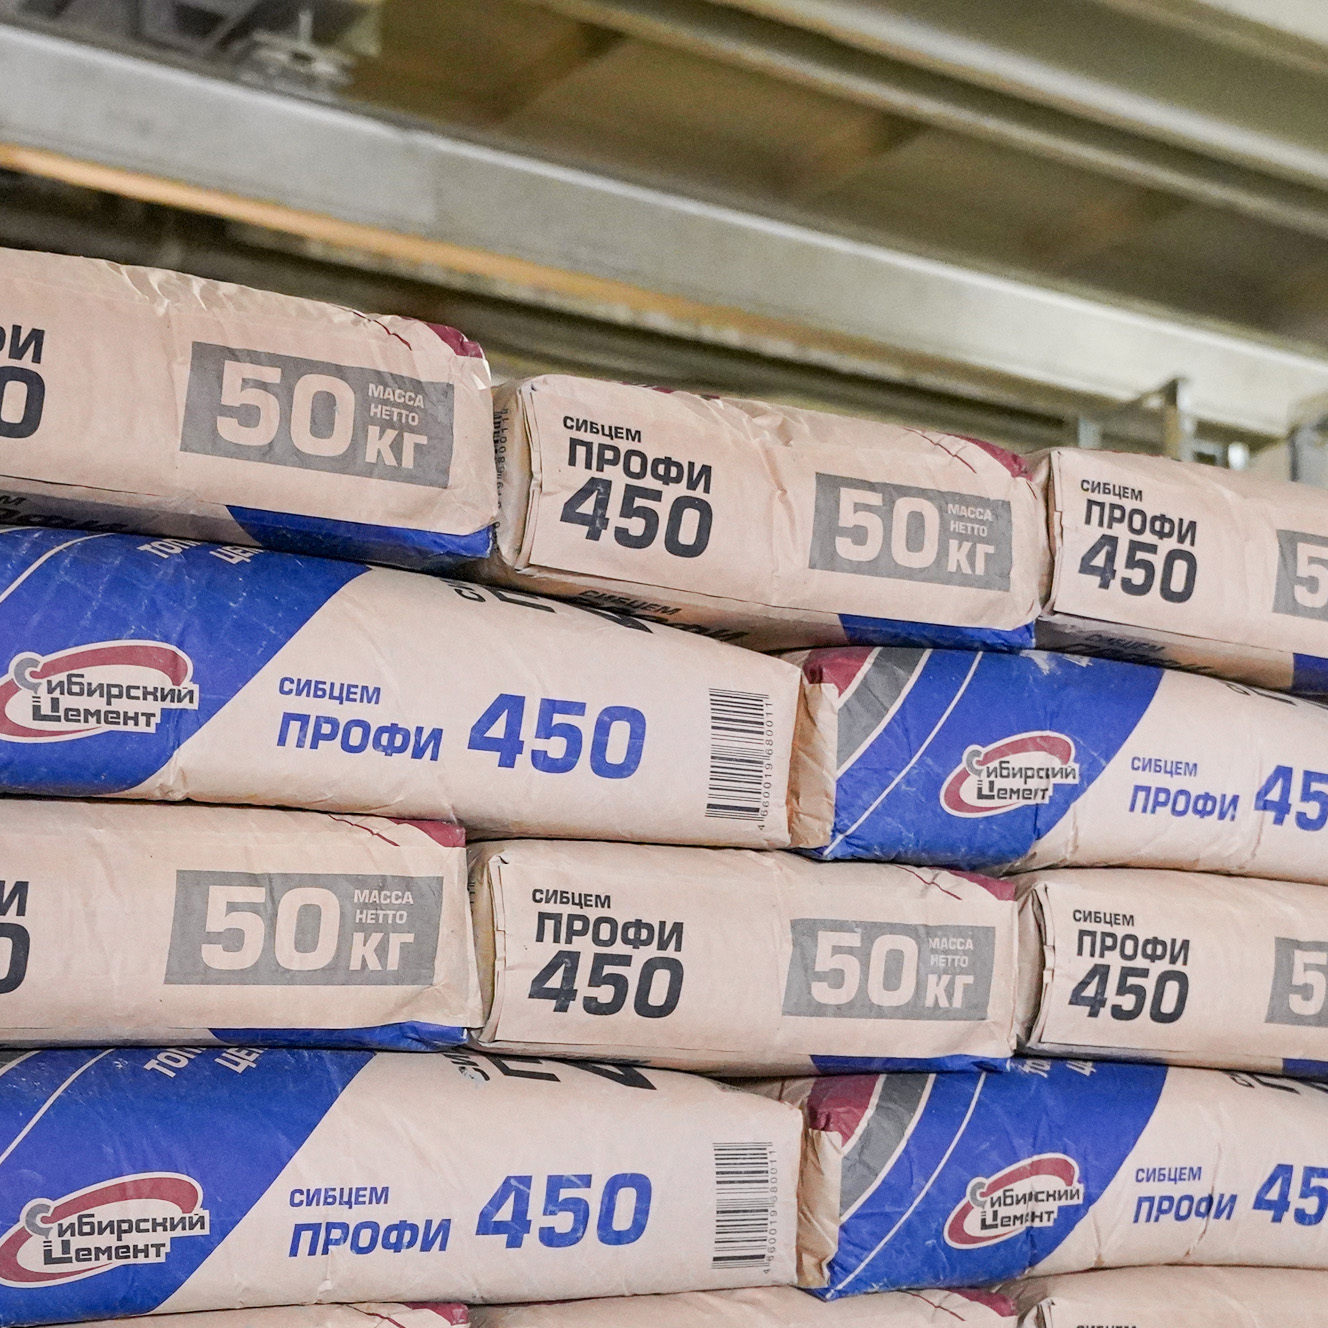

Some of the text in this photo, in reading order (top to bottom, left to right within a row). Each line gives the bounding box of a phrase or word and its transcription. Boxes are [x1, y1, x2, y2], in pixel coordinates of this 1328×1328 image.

[368, 382, 425, 409] МАССА
[216, 361, 428, 469] 50 КГ
[370, 403, 419, 426] НЕТТО
[563, 416, 641, 443] СИБЦЕМ
[568, 437, 713, 493] ПРОФИ
[1080, 479, 1142, 502] СИБЦЕМ
[560, 476, 713, 559] 450
[947, 503, 993, 522] МАССА
[950, 520, 988, 537] НЕТТО
[1085, 499, 1197, 547] ПРОФИ
[834, 487, 995, 576] 50 КГ
[1079, 535, 1197, 603] 450
[13, 656, 195, 705] Сибирский
[278, 677, 381, 704] СИБЦЕМ
[33, 696, 156, 729] Цемент
[277, 693, 647, 779] ПРОФИ 450
[1131, 756, 1197, 777] СИБЦЕМ
[1129, 784, 1239, 822] ПРОФИ
[354, 888, 413, 906] МАССА
[532, 888, 611, 909] СИБЦЕМ
[201, 885, 414, 971] 50 КГ
[355, 909, 407, 925] НЕТТО
[535, 912, 684, 951] ПРОФИ
[1073, 909, 1135, 927] СИБЦЕМ
[928, 937, 974, 950] МАССА
[1076, 930, 1190, 967] ПРОФИ
[811, 930, 974, 1009] 50 КГ
[930, 954, 968, 967] НЕТТО
[528, 950, 684, 1018] 450
[1069, 965, 1190, 1023] 450
[1135, 1166, 1202, 1184] СИБЦЕМ
[289, 1186, 389, 1209] СИБЦЕМ
[1133, 1192, 1238, 1224] ПРОФИ
[25, 1198, 206, 1240] Сибирский
[288, 1173, 652, 1257] ПРОФИ 450
[44, 1239, 167, 1265] Цемент
